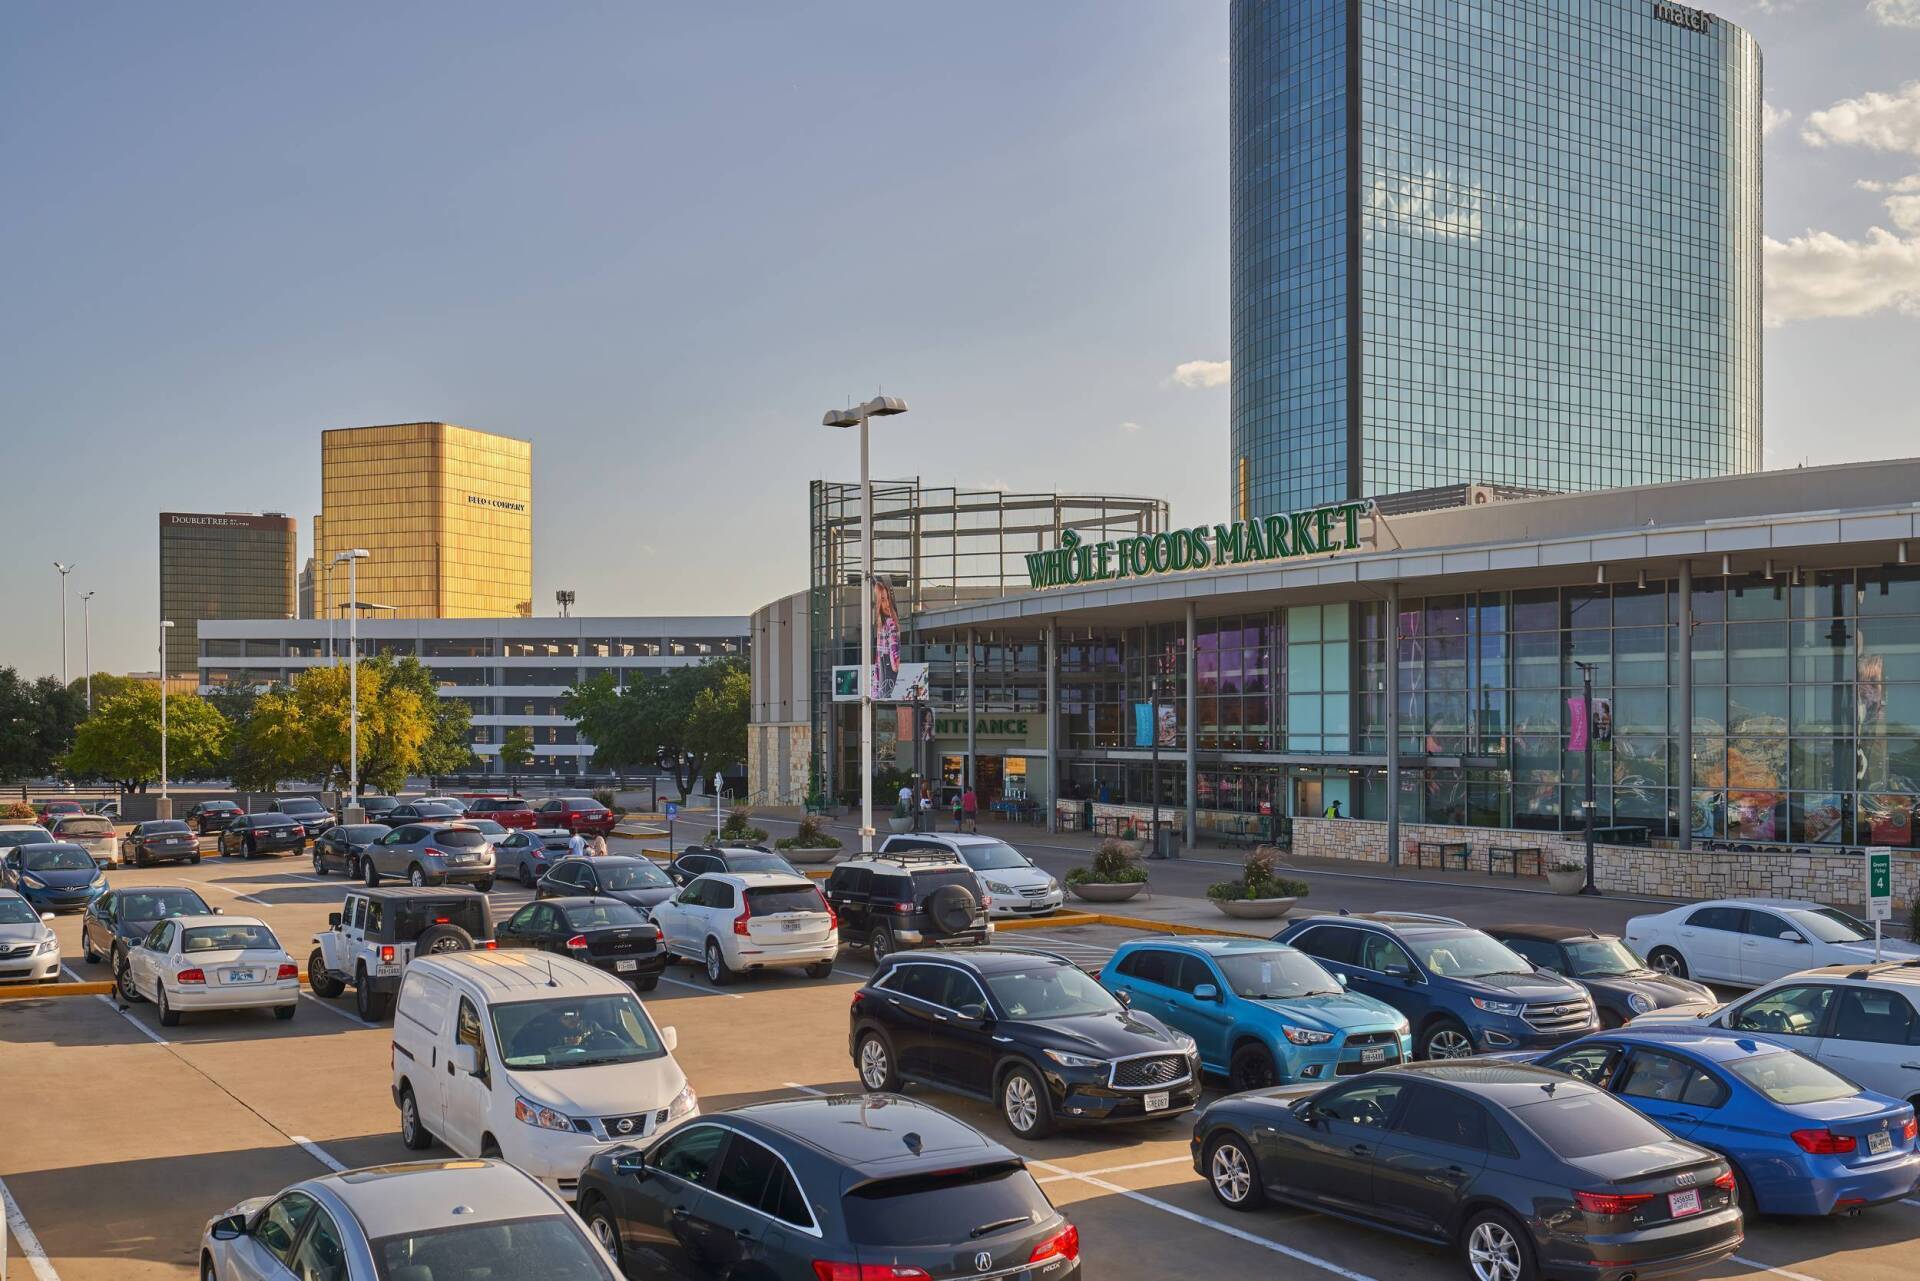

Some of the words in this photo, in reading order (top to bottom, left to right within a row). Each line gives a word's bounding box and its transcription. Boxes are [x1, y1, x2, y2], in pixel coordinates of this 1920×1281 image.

[1657, 3, 1710, 33] match
[492, 500, 525, 511] COMPANY
[1025, 529, 1117, 590] WHOLE
[1116, 526, 1211, 576] FOODS
[1214, 502, 1362, 566] MARKET
[1876, 877, 1884, 889] 4
[1042, 1261, 1061, 1273] RDX
